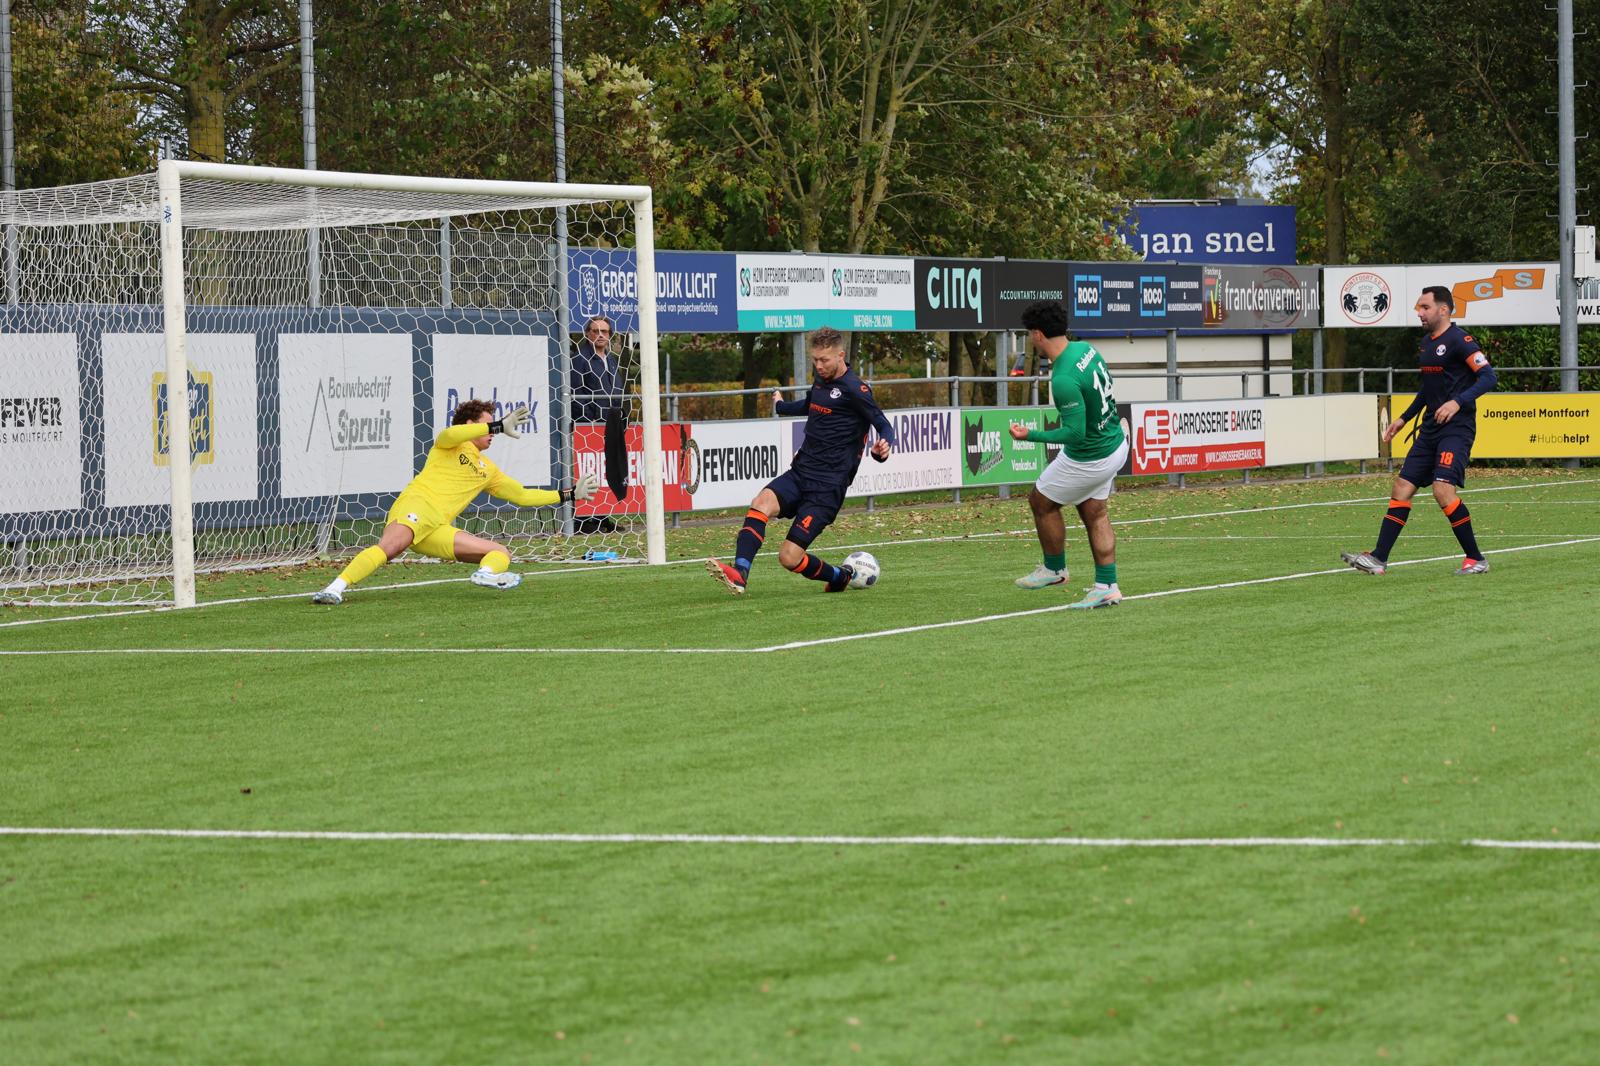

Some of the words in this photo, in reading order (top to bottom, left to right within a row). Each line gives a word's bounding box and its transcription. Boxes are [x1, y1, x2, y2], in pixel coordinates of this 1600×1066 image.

[1205, 222, 1275, 254] snel
[685, 272, 717, 298] LICHT
[927, 266, 983, 323] cinq
[1077, 287, 1099, 304] ROCO
[1142, 288, 1163, 305] ROCO
[1225, 280, 1320, 318] franckenvermeij.nl
[328, 376, 392, 402] Bouwbedrijf
[336, 408, 392, 446] Spruit
[1172, 411, 1229, 435] CARROSSERIE
[1231, 409, 1262, 432] BAKKER
[1482, 408, 1536, 425] Jongeneel
[1538, 407, 1590, 422] Montfoort
[892, 411, 952, 454] ARNHEM
[977, 431, 1001, 453] KATS
[1528, 433, 1590, 445] #Hubohelpt
[703, 445, 779, 483] FEYENOORD
[1440, 451, 1454, 466] 18
[801, 515, 813, 529] 4
